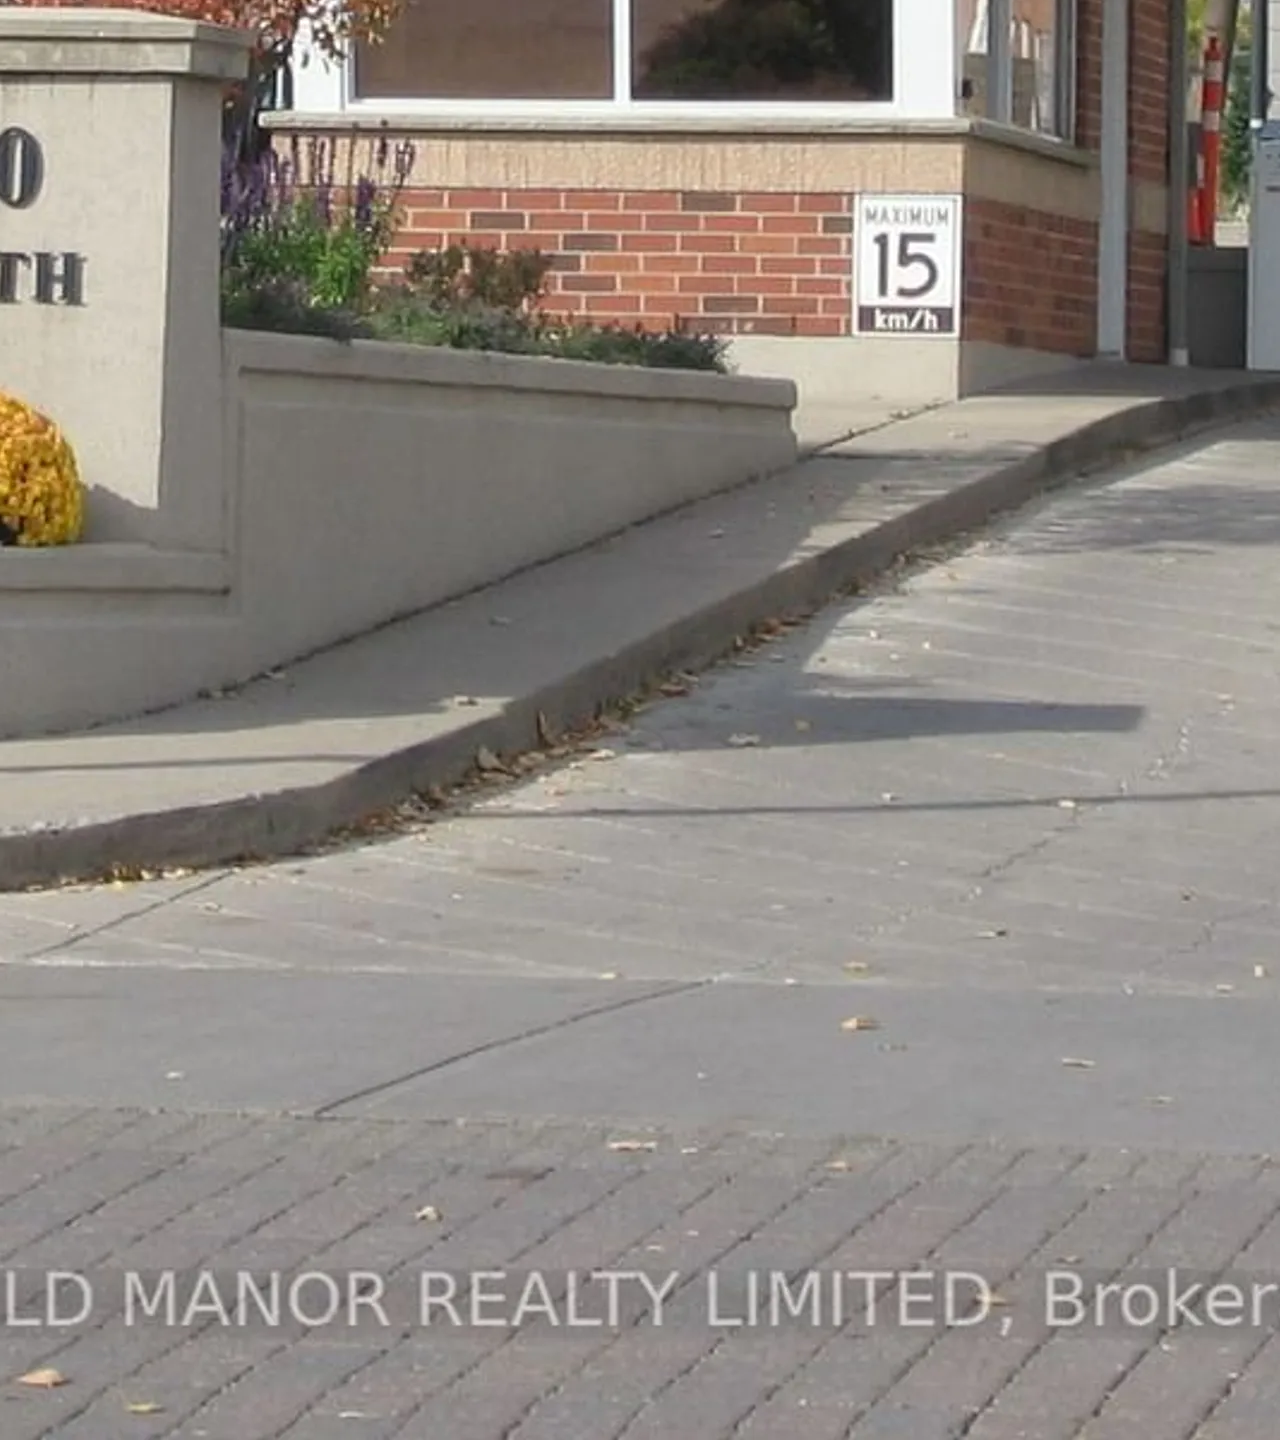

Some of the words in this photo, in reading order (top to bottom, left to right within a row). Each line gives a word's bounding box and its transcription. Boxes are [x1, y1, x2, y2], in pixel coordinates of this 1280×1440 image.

[865, 206, 950, 227] MAXIMUM
[873, 232, 938, 298] 15
[874, 307, 939, 331] km/h
